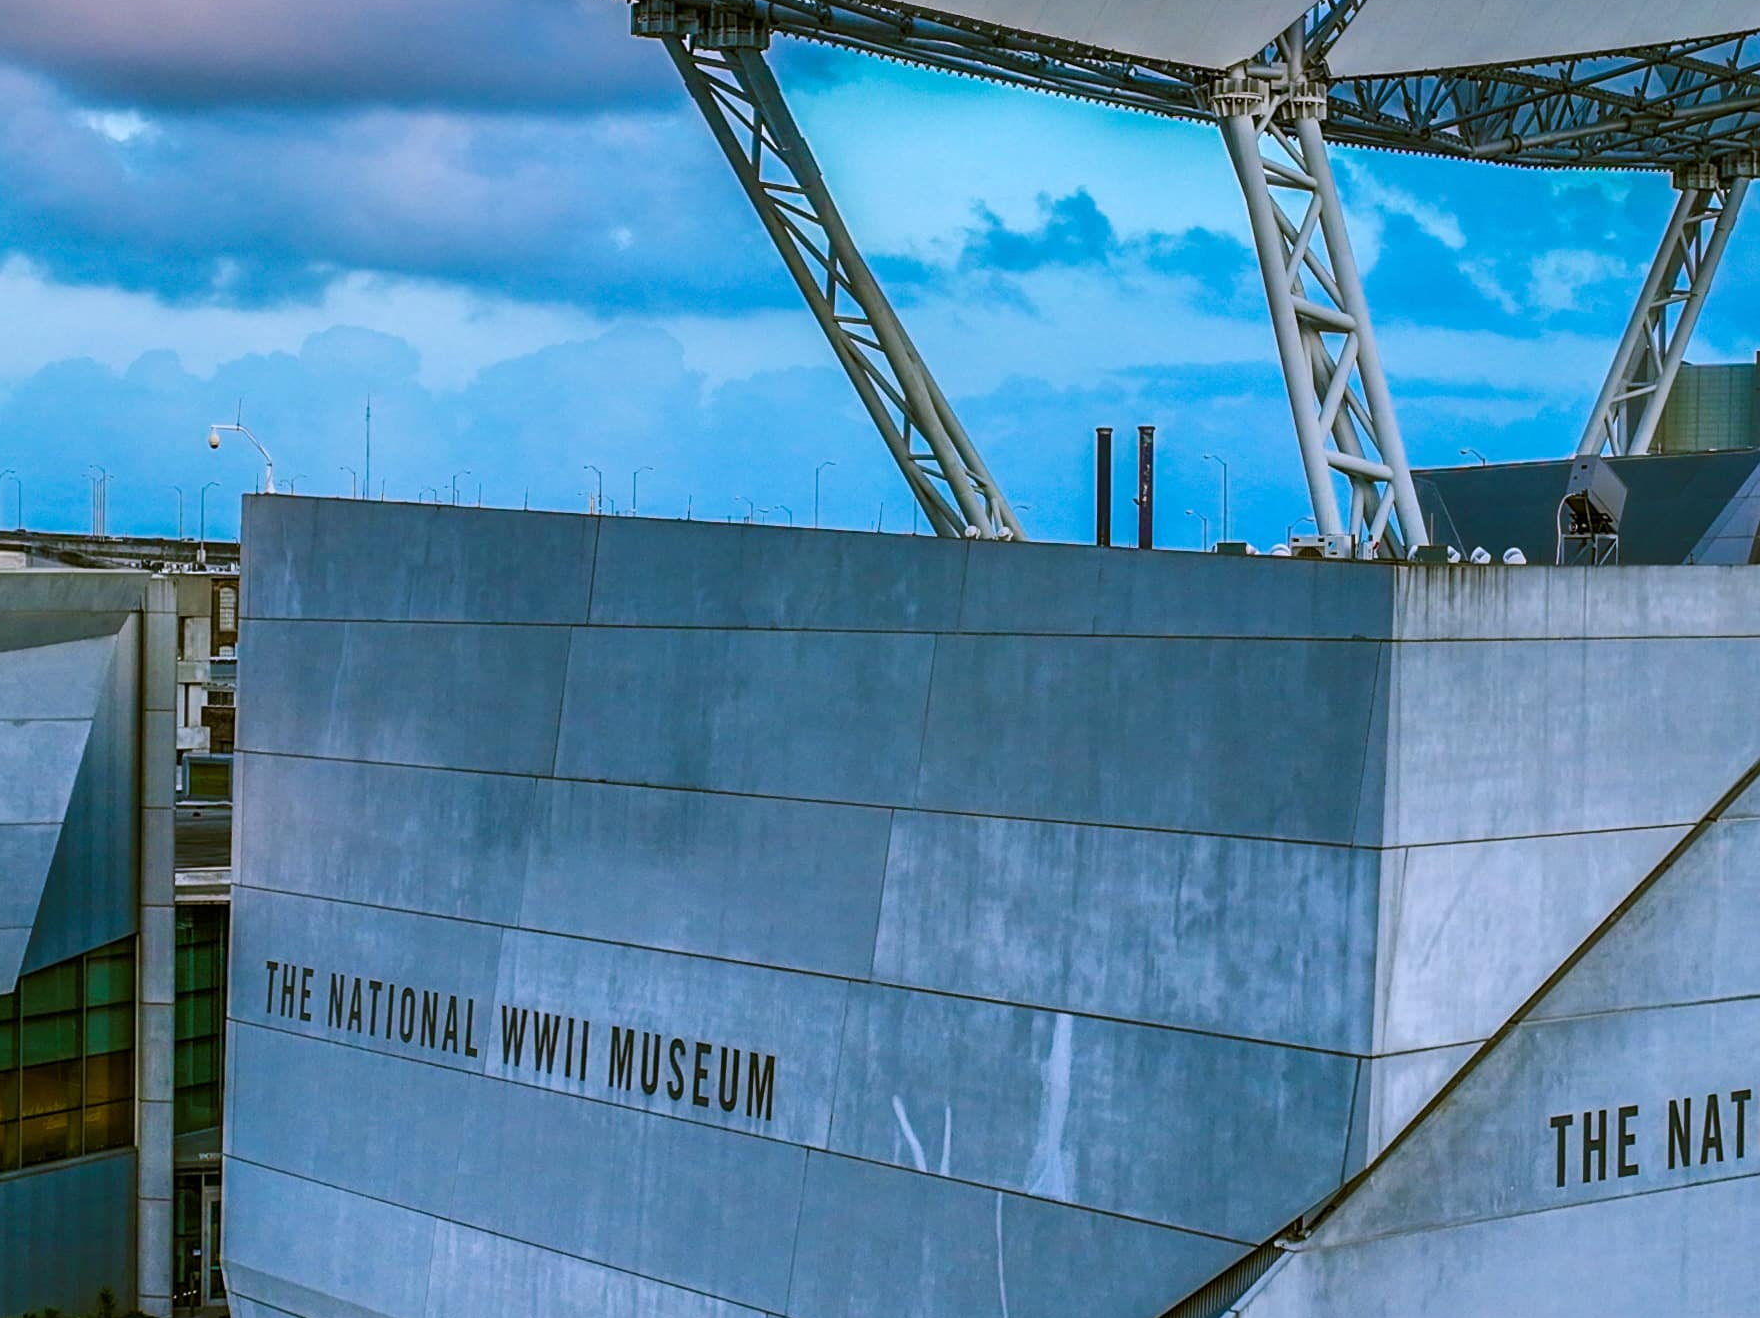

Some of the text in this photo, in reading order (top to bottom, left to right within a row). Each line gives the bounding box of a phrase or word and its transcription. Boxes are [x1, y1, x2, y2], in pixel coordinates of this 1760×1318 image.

[266, 961, 776, 1121] THE NATIONAL WWII MUSEUM
[1550, 1105, 1640, 1188] THE
